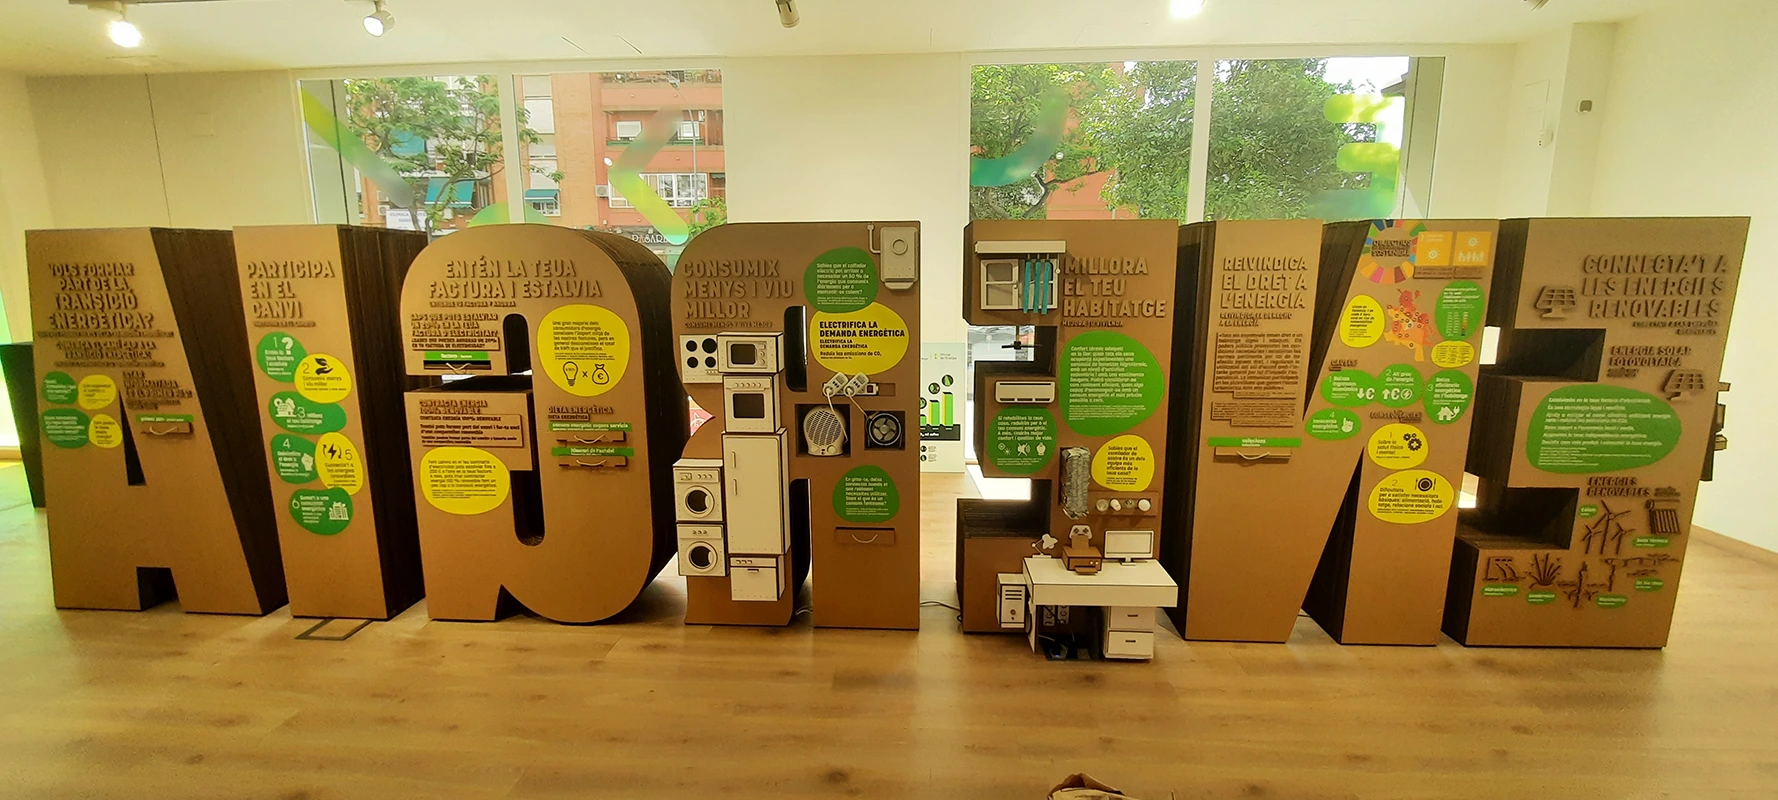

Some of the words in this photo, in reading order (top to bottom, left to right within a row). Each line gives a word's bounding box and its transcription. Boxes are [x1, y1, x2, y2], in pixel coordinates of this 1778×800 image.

[83, 263, 135, 277] FORMAR
[247, 261, 335, 278] PARTICIPA
[446, 256, 500, 279] ENTÉN
[507, 259, 529, 278] LA
[535, 259, 577, 278] TEUA
[685, 260, 779, 277] CONSUMIX
[1064, 257, 1149, 275] MILLORA
[1223, 257, 1307, 271] REIVINDICA
[1584, 255, 1707, 274] CONNECTA'T
[1713, 255, 1728, 273] A
[60, 278, 91, 291] PART
[95, 278, 111, 291] DE
[115, 278, 129, 291] LA
[251, 281, 271, 299] EN
[278, 281, 296, 299] EL
[429, 281, 505, 299] FACTURA
[510, 280, 516, 298] I
[523, 280, 602, 298] ESTALVIA
[685, 281, 746, 298] MENYS
[752, 281, 758, 298] I
[764, 281, 794, 298] VIU
[1064, 279, 1085, 296] EL
[1091, 279, 1126, 296] TEU
[1222, 274, 1241, 290] EL
[1247, 274, 1291, 290] DRET
[1295, 274, 1307, 290] A
[1582, 277, 1618, 296] LES
[1624, 277, 1725, 296] ENERGIES
[55, 289, 138, 310] TRANSICIÓ
[1221, 293, 1305, 309] L'ENERGIA
[253, 301, 303, 318] CANVI
[686, 301, 750, 319] MILLOR
[1063, 300, 1166, 318] HABITATGE
[1589, 299, 1721, 318] RENOVABLES
[49, 309, 154, 329] ENERGÈTICA?
[859, 328, 905, 337] ENERGÈTICA
[1610, 346, 1655, 355] ENERGIA
[303, 363, 309, 374] 2
[297, 407, 305, 418] 3
[570, 405, 613, 414] ENERGÈTICA
[283, 438, 290, 449] 4
[345, 449, 352, 460] 5
[1588, 477, 1637, 486] ENERGIES
[1587, 487, 1650, 496] RENOVABLES
[292, 499, 299, 509] 6
